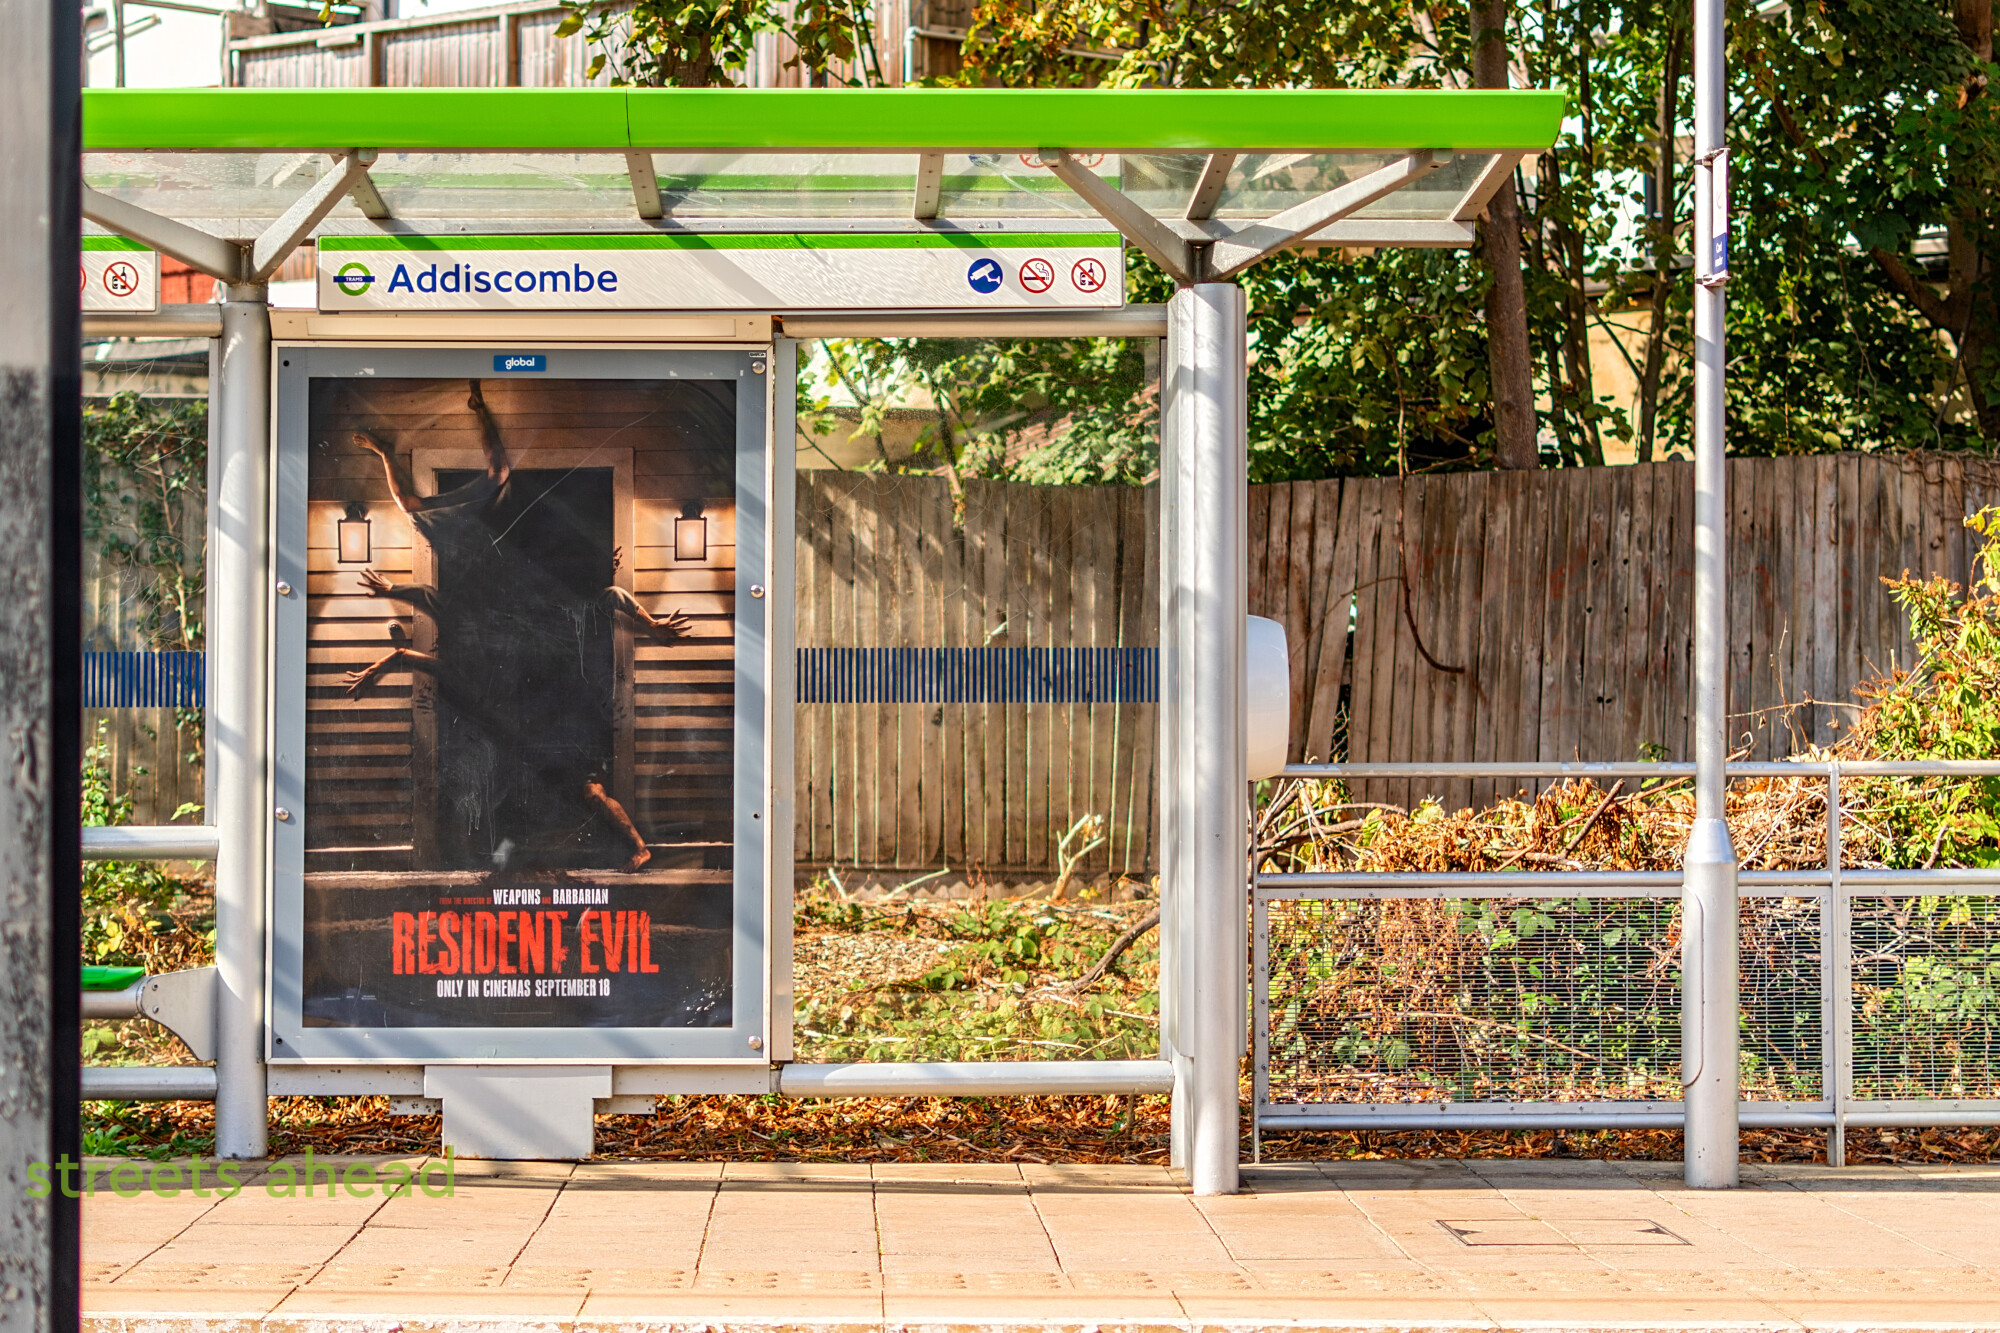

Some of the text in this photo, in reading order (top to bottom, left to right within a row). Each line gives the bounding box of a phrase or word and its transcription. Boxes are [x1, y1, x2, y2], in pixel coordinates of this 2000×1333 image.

[387, 262, 618, 293] Addiscombe
[505, 357, 535, 370] global
[493, 888, 541, 905] WEAPONS
[552, 888, 609, 905] BARBARIAN
[392, 909, 660, 975] RESIDENT EVIL
[436, 978, 611, 998] ONLY IN CINEMAS SEPTEMBER 18
